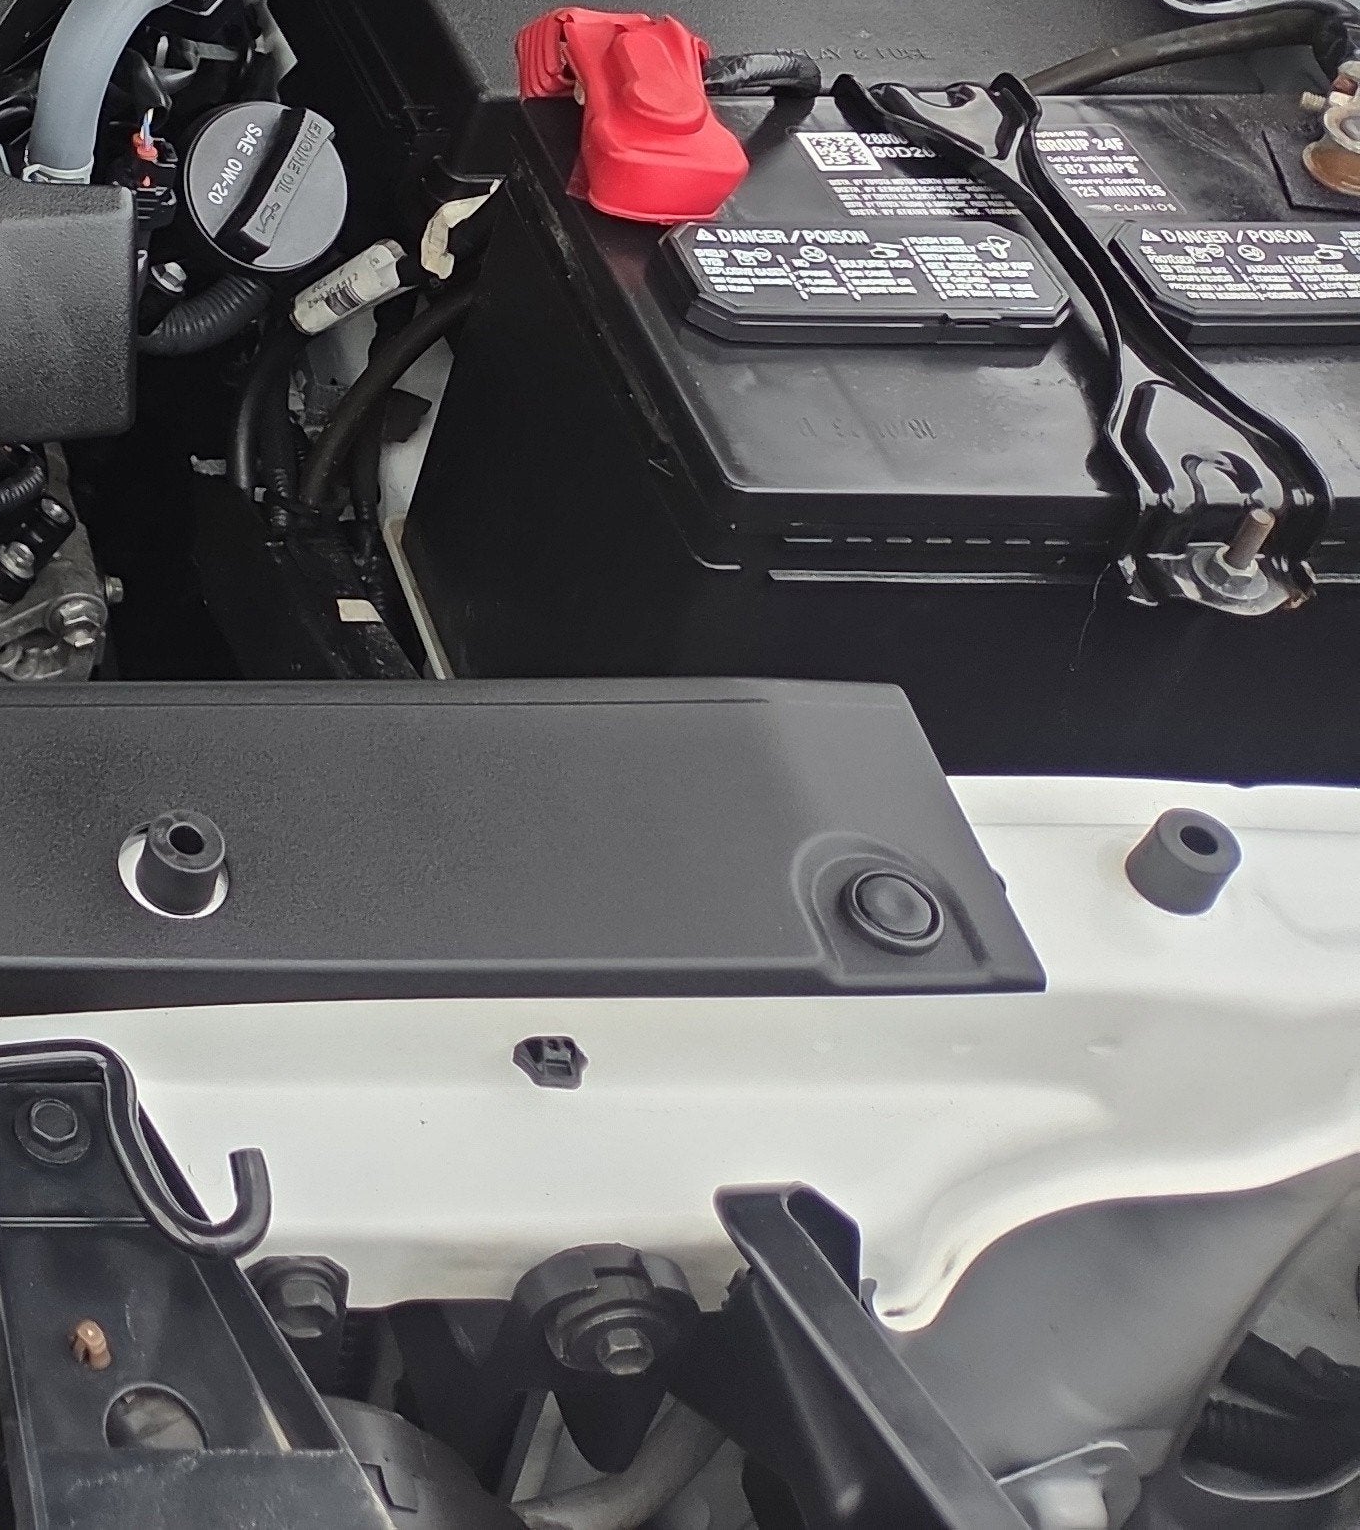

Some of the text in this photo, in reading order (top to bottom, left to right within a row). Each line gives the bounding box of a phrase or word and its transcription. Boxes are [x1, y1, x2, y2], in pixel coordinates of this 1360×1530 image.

[1035, 130, 1065, 138] eplace
[1036, 137, 1124, 151] GROUP 24F
[206, 122, 263, 206] SAE 0W-20
[273, 121, 322, 198] ENGINE OIL
[1090, 162, 1139, 174] AMPS
[1064, 177, 1146, 185] Reserve Capacity
[1071, 185, 1167, 197] 125 MINUTES
[1113, 203, 1177, 212] CLARIOS
[717, 228, 788, 245] DANGER
[803, 229, 870, 245] POISON
[1160, 229, 1233, 244] DANGER
[1245, 229, 1316, 244] POISON
